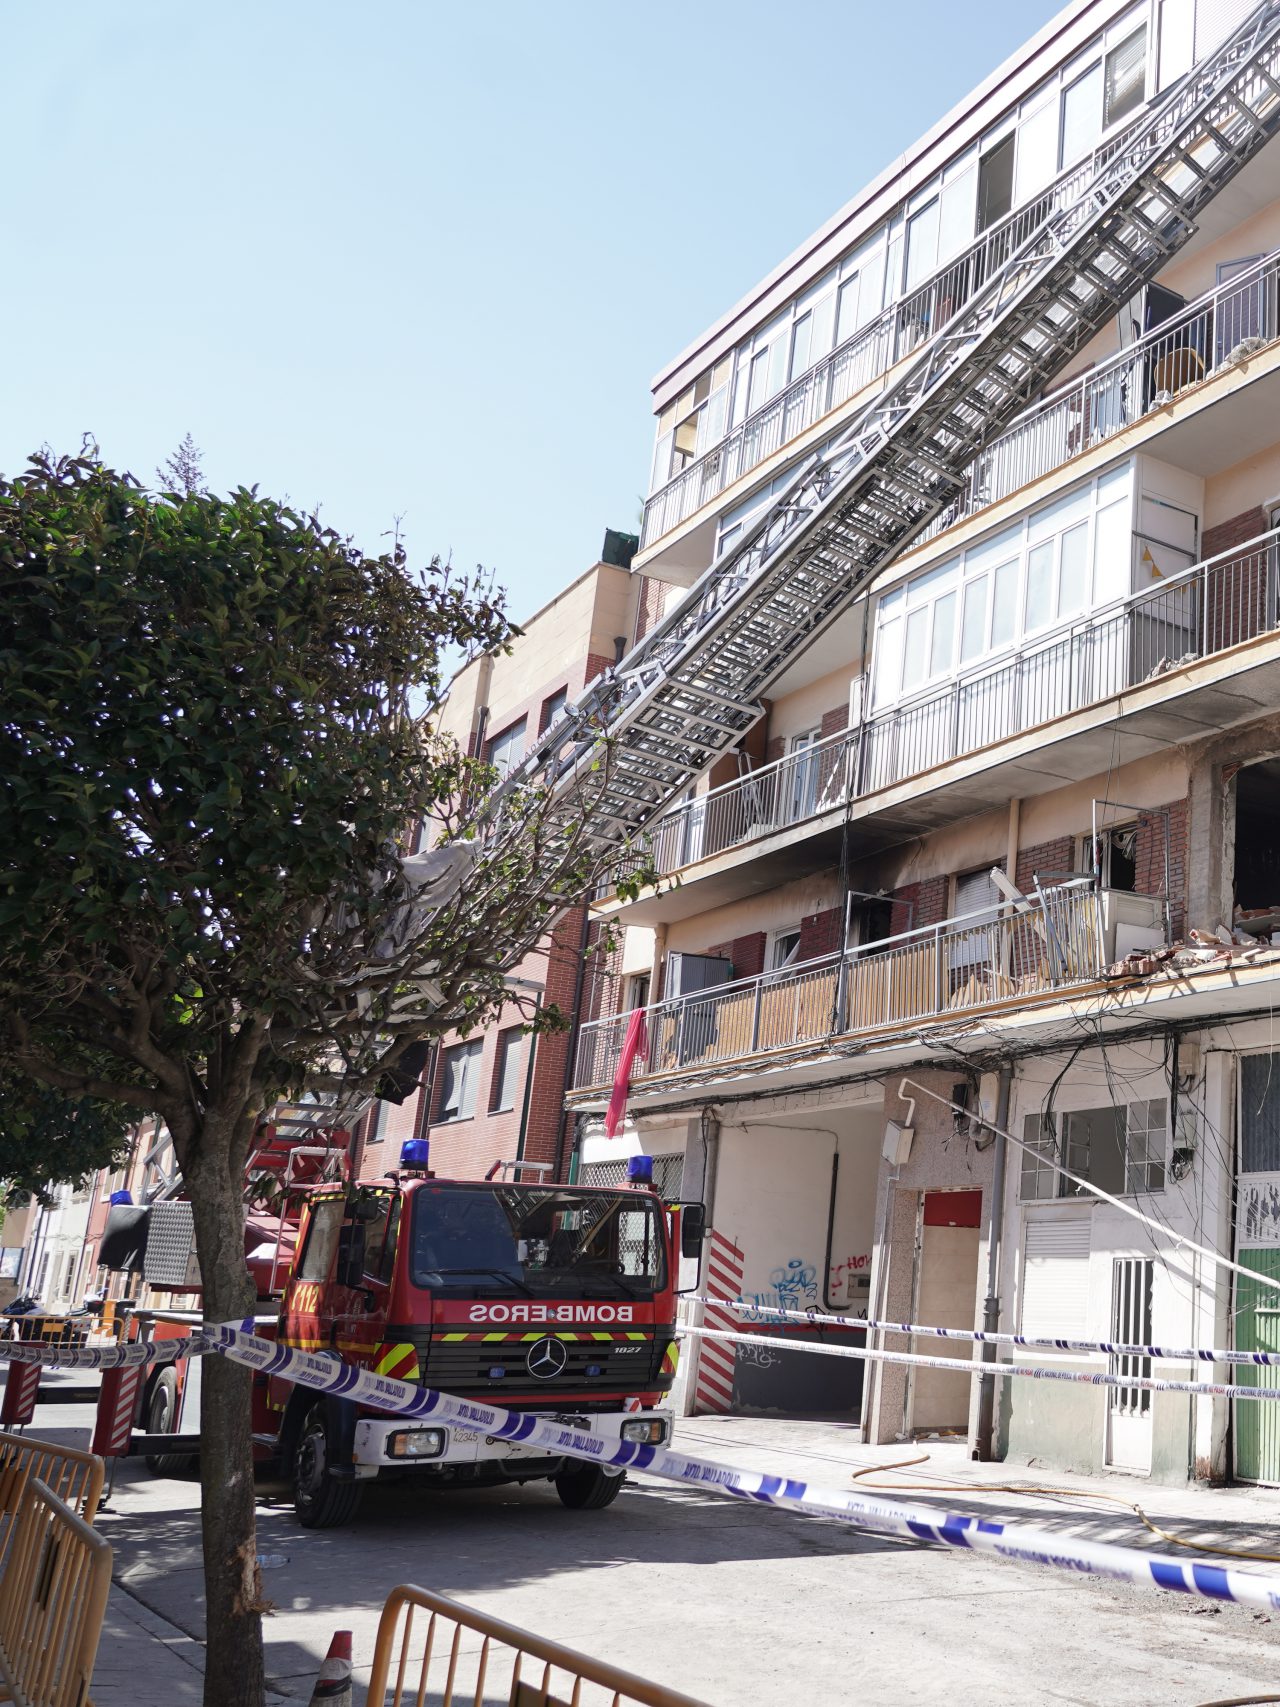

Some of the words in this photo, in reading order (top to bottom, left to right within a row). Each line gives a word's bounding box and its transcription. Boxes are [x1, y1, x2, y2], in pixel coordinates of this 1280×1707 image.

[298, 1285, 319, 1313] 112
[453, 1431, 479, 1443] 42345
[558, 1432, 571, 1446] AYTO.
[572, 1435, 604, 1454] VALLADOLID
[682, 1463, 699, 1477] AYTO.
[701, 1466, 740, 1488] VALLADOLID
